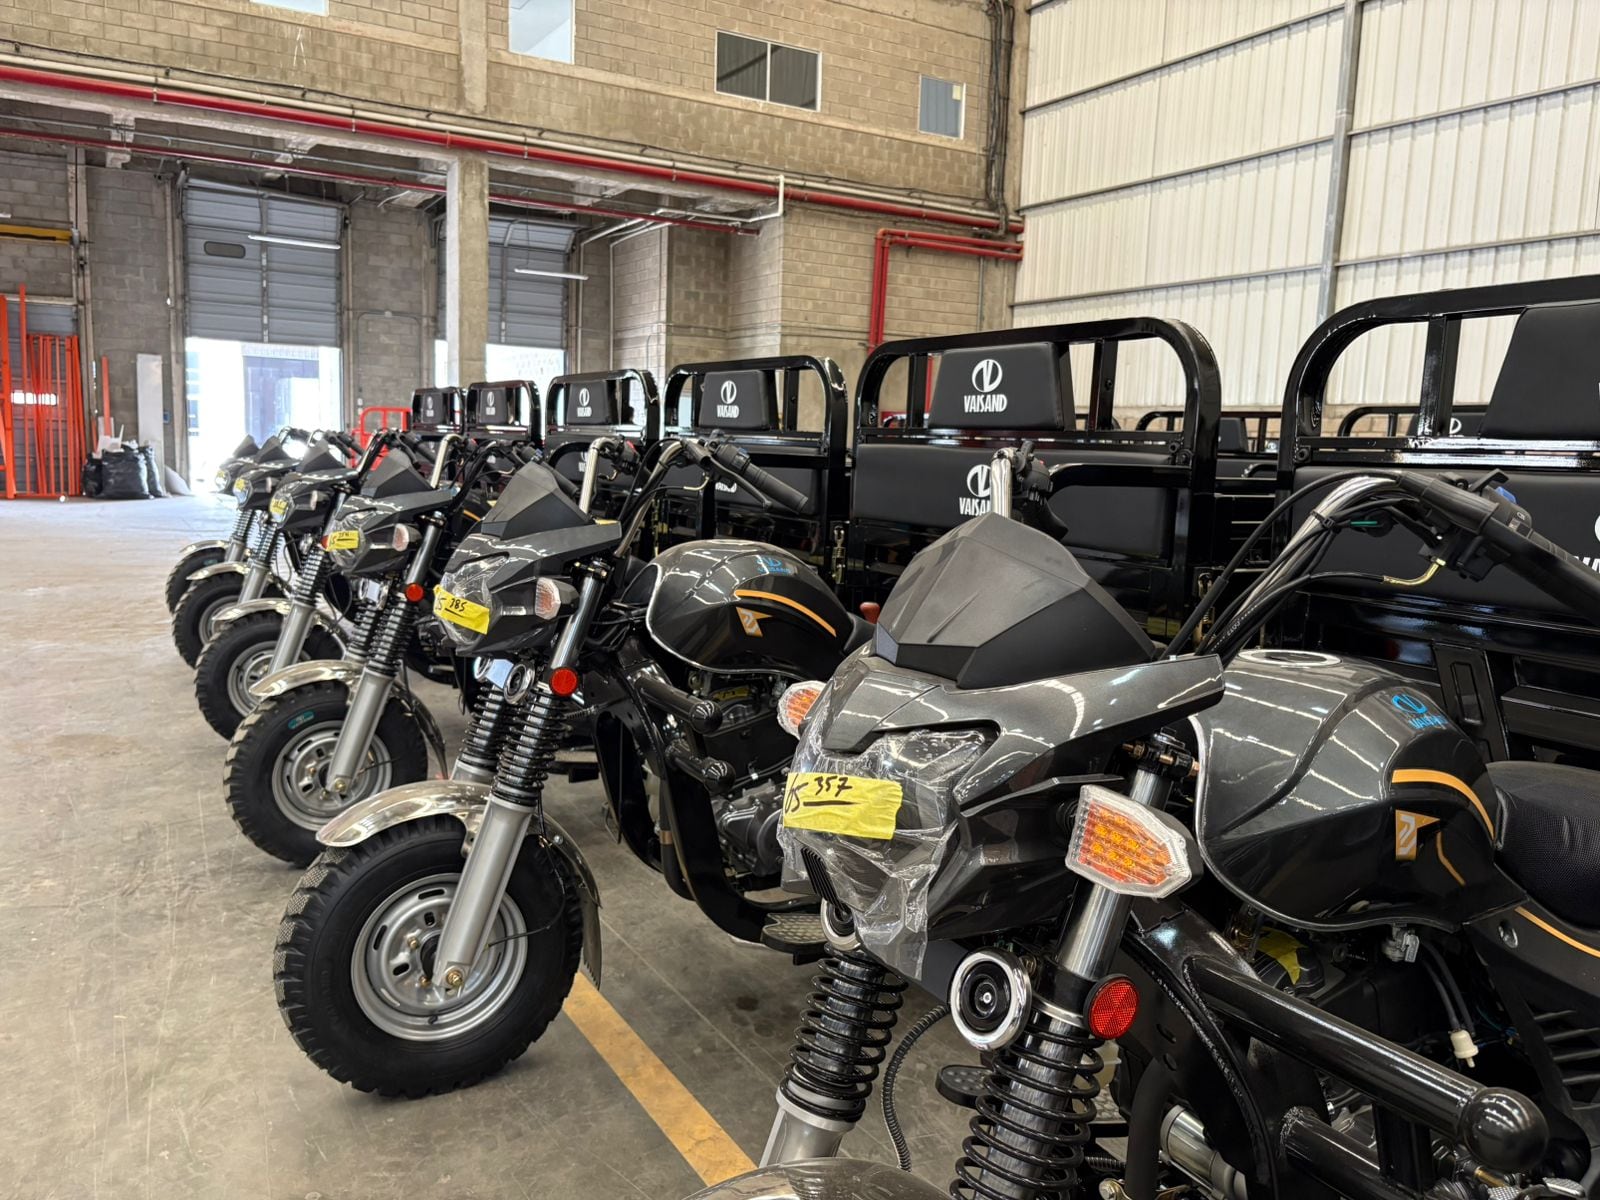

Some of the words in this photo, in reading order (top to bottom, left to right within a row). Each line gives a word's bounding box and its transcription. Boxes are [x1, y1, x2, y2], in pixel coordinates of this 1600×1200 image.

[717, 404, 740, 418] VAISAND
[964, 394, 1008, 413] VAISAND
[959, 497, 991, 515] VAISA
[814, 775, 853, 798] 357
